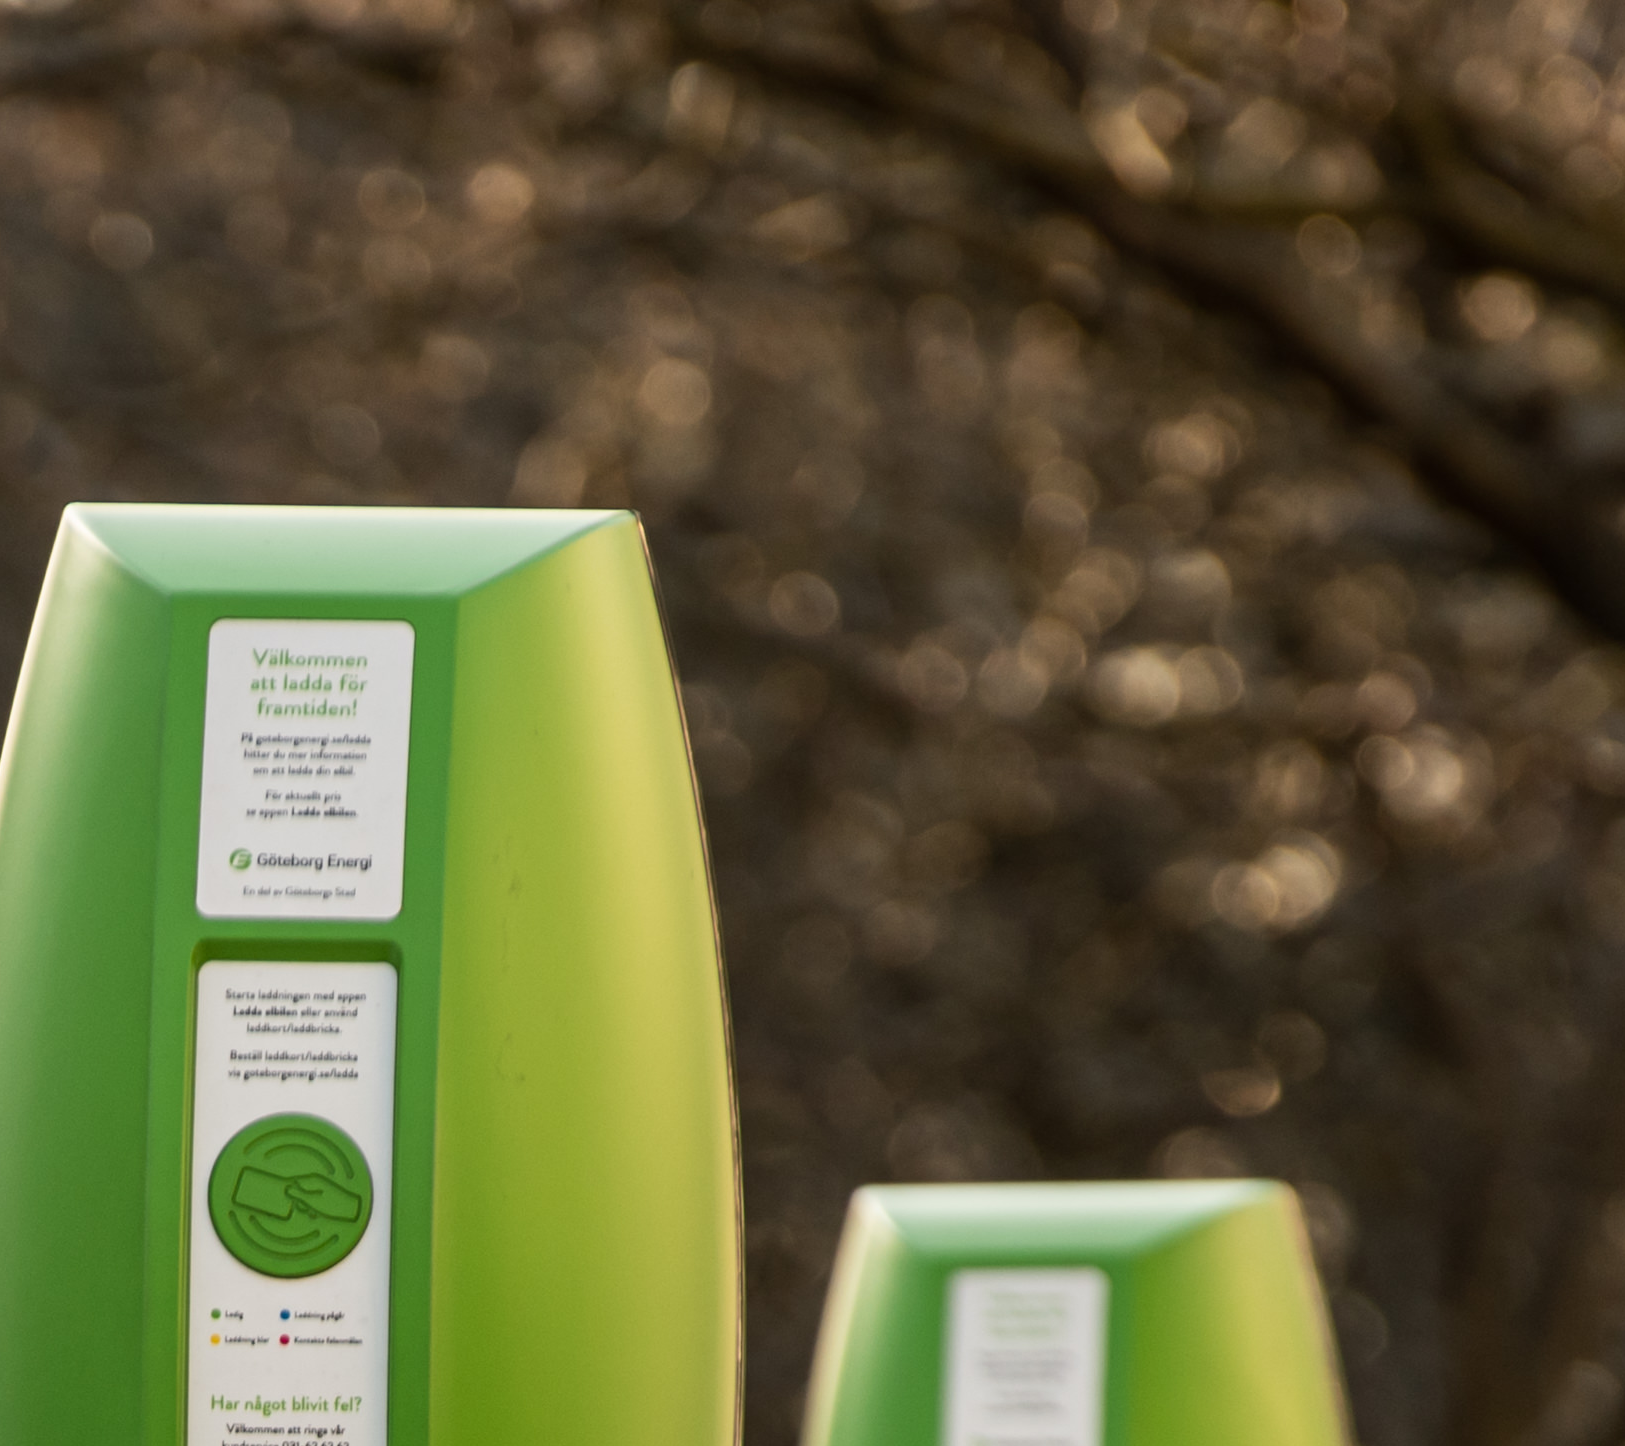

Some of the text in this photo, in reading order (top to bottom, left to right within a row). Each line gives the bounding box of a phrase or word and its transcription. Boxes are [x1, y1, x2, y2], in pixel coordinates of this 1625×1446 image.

[252, 647, 368, 667] Välkommen
[250, 672, 367, 692] att ladda för
[257, 697, 357, 717] framtiden!
[273, 749, 285, 759] du
[288, 752, 307, 760] mer
[310, 748, 367, 760] information
[288, 765, 313, 775] ladda
[265, 789, 282, 800] För
[291, 806, 321, 817] Ladda
[257, 852, 372, 871] Göteborg Energi
[335, 887, 356, 897] Stad
[225, 988, 366, 1003] Starta laddningen med appen
[233, 1005, 358, 1017] Ladda elbilen eller använd
[230, 1049, 358, 1062] Beställ laddkort/laddbricka
[244, 1067, 359, 1081] goteborgenergi.se/ladda
[211, 1395, 362, 1417] Har något blivit fel?
[226, 1423, 345, 1438] Välkommen att ringa vår
